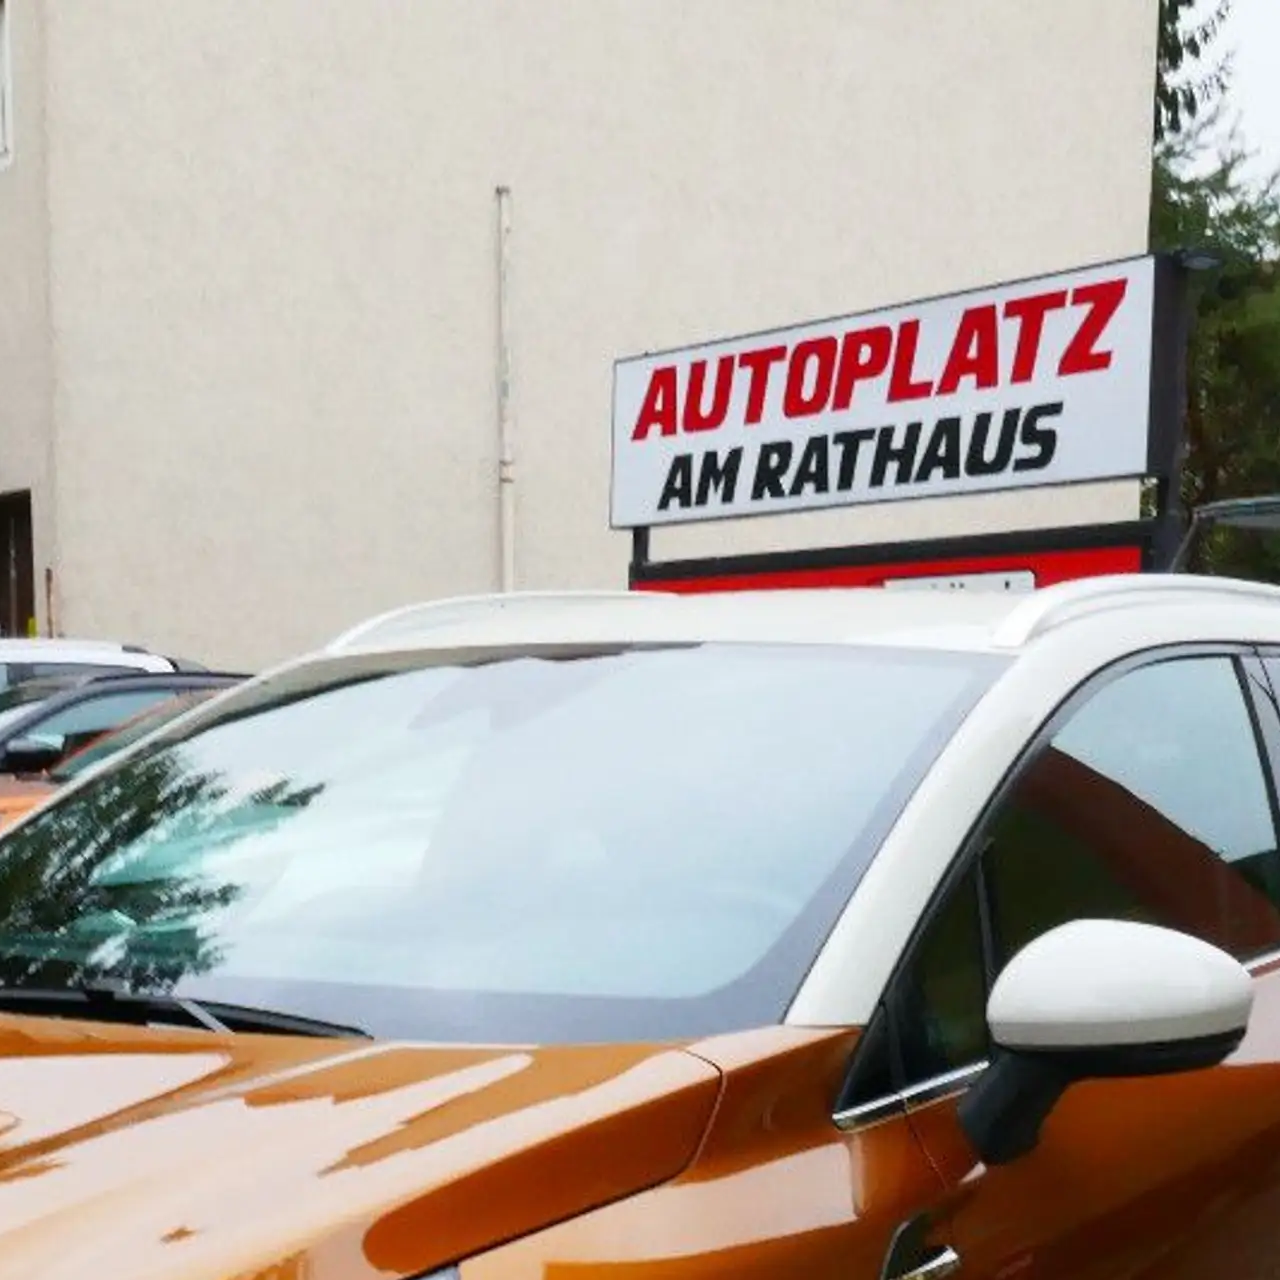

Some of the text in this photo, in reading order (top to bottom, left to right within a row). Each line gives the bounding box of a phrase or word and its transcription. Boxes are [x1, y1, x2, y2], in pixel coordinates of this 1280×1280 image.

[631, 278, 1129, 441] AUTOPLATZ
[657, 402, 1064, 511] AM RATHAUS
